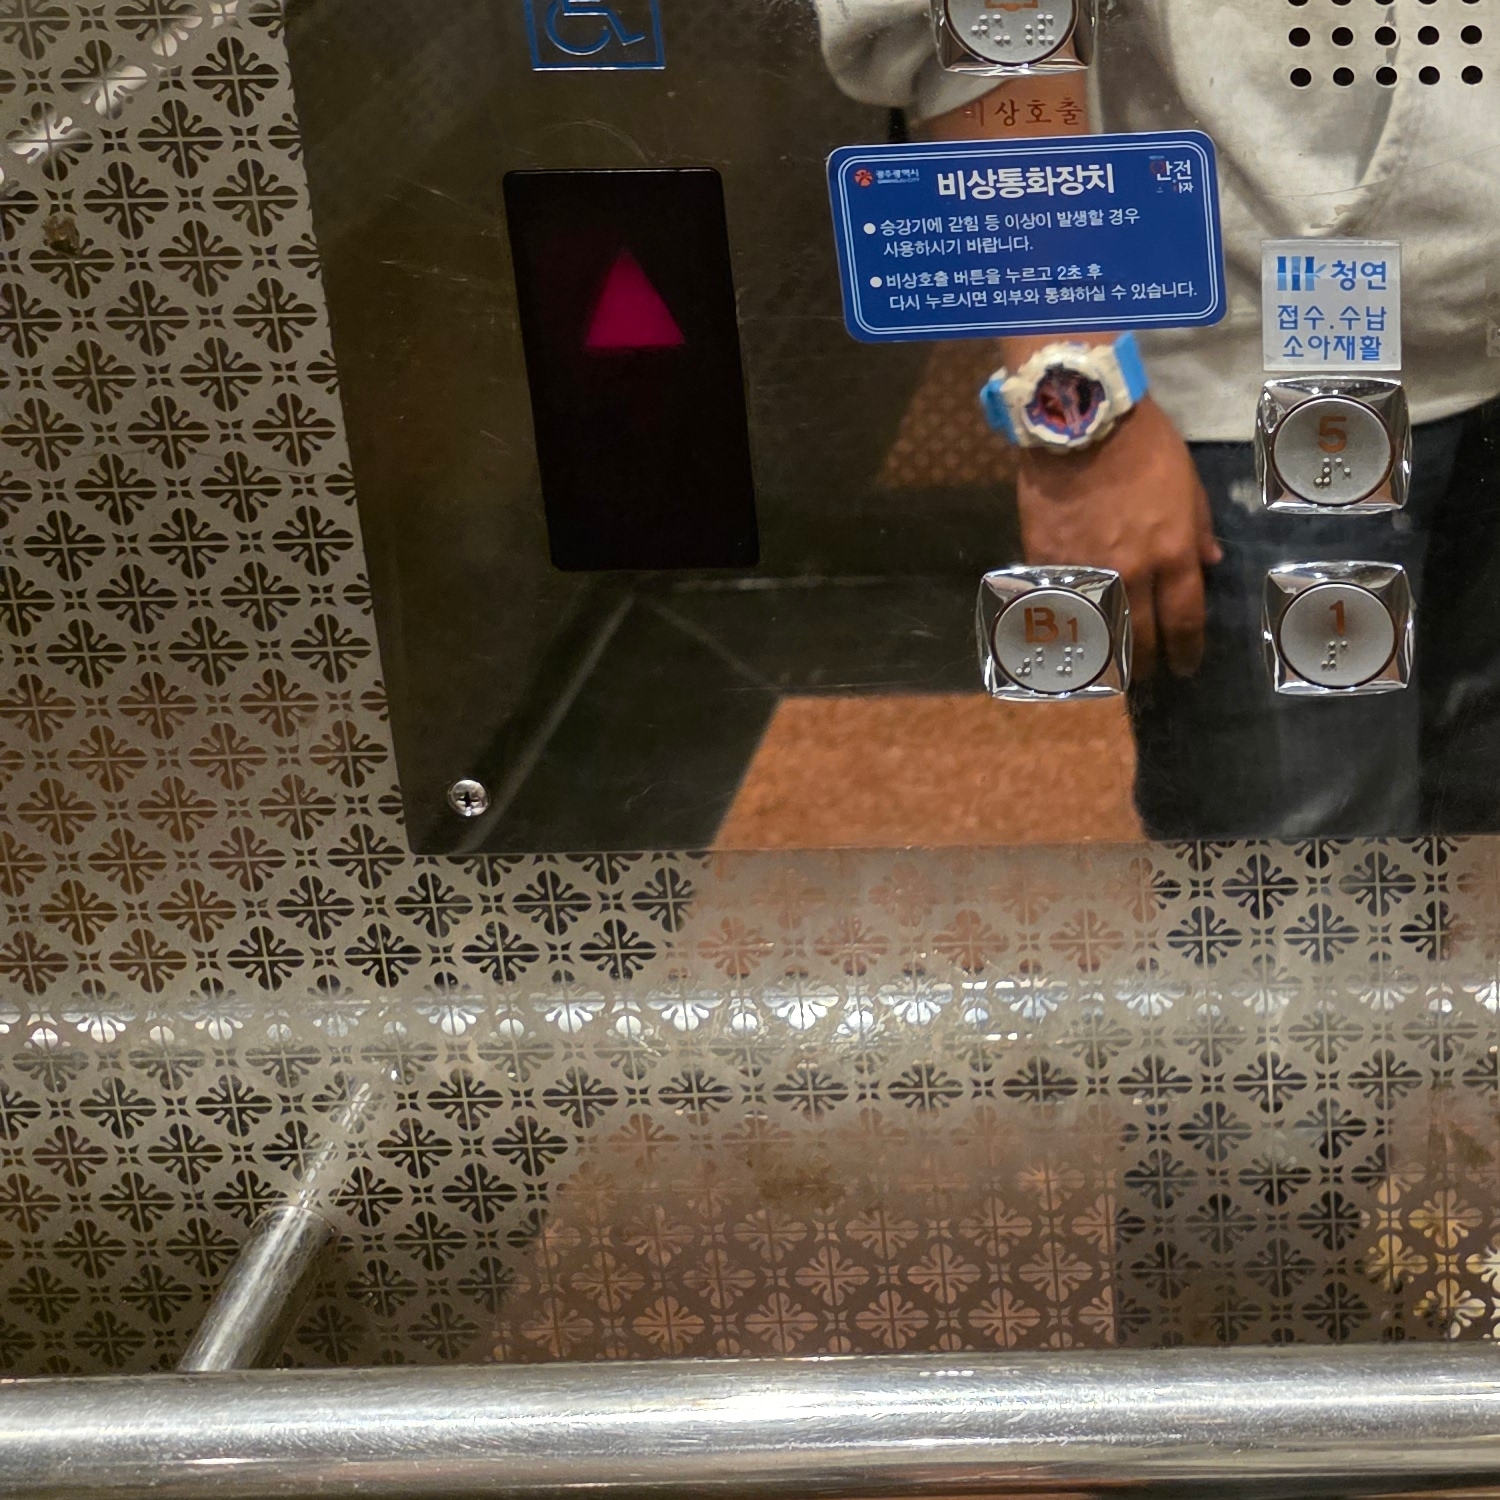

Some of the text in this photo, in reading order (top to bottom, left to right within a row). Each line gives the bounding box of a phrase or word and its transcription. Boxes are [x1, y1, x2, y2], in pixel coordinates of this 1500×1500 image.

[963, 97, 1084, 127] 비상호출
[937, 163, 1114, 200] 비상통화장치
[880, 208, 1141, 237] 승강기에 갇힘 등 이상이 발생할 경우
[884, 235, 1034, 257] 사용하시기 바랍니다.
[886, 263, 1103, 289] 비상호출 버튼을 누르고 2초 후
[1330, 260, 1387, 291] 청연
[889, 281, 1198, 311] 다시 누르시면 외부와 통화하실 수 있습니다.
[1282, 335, 1382, 360] 소아재활
[1317, 415, 1347, 453] 5
[1024, 606, 1079, 643] B1
[1328, 600, 1346, 636] 1
